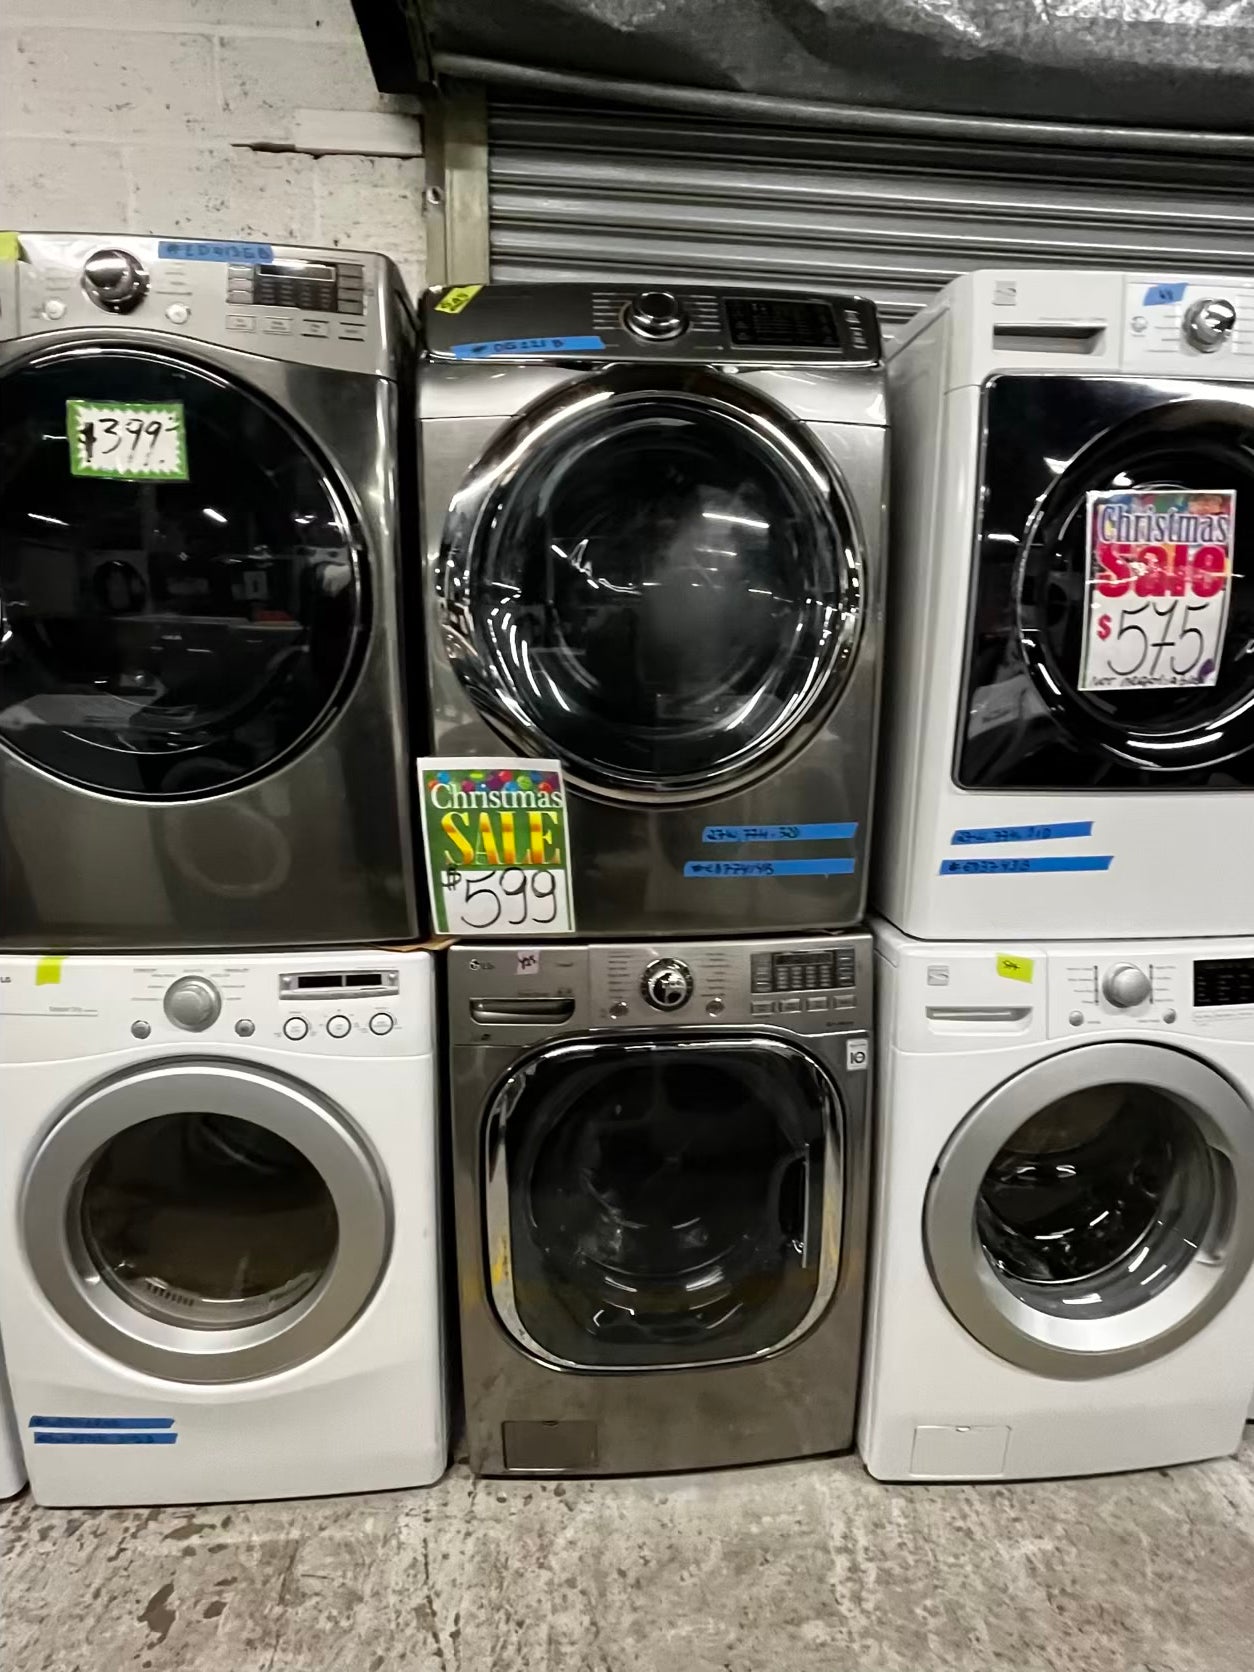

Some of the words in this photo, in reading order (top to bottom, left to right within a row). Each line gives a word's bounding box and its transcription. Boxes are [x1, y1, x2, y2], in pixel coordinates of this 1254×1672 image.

[1098, 504, 1230, 545] Christmas
[1095, 544, 1228, 598] Sale
[431, 783, 564, 810] Christmas
[441, 810, 562, 866] SALE
[442, 864, 558, 928] $599
